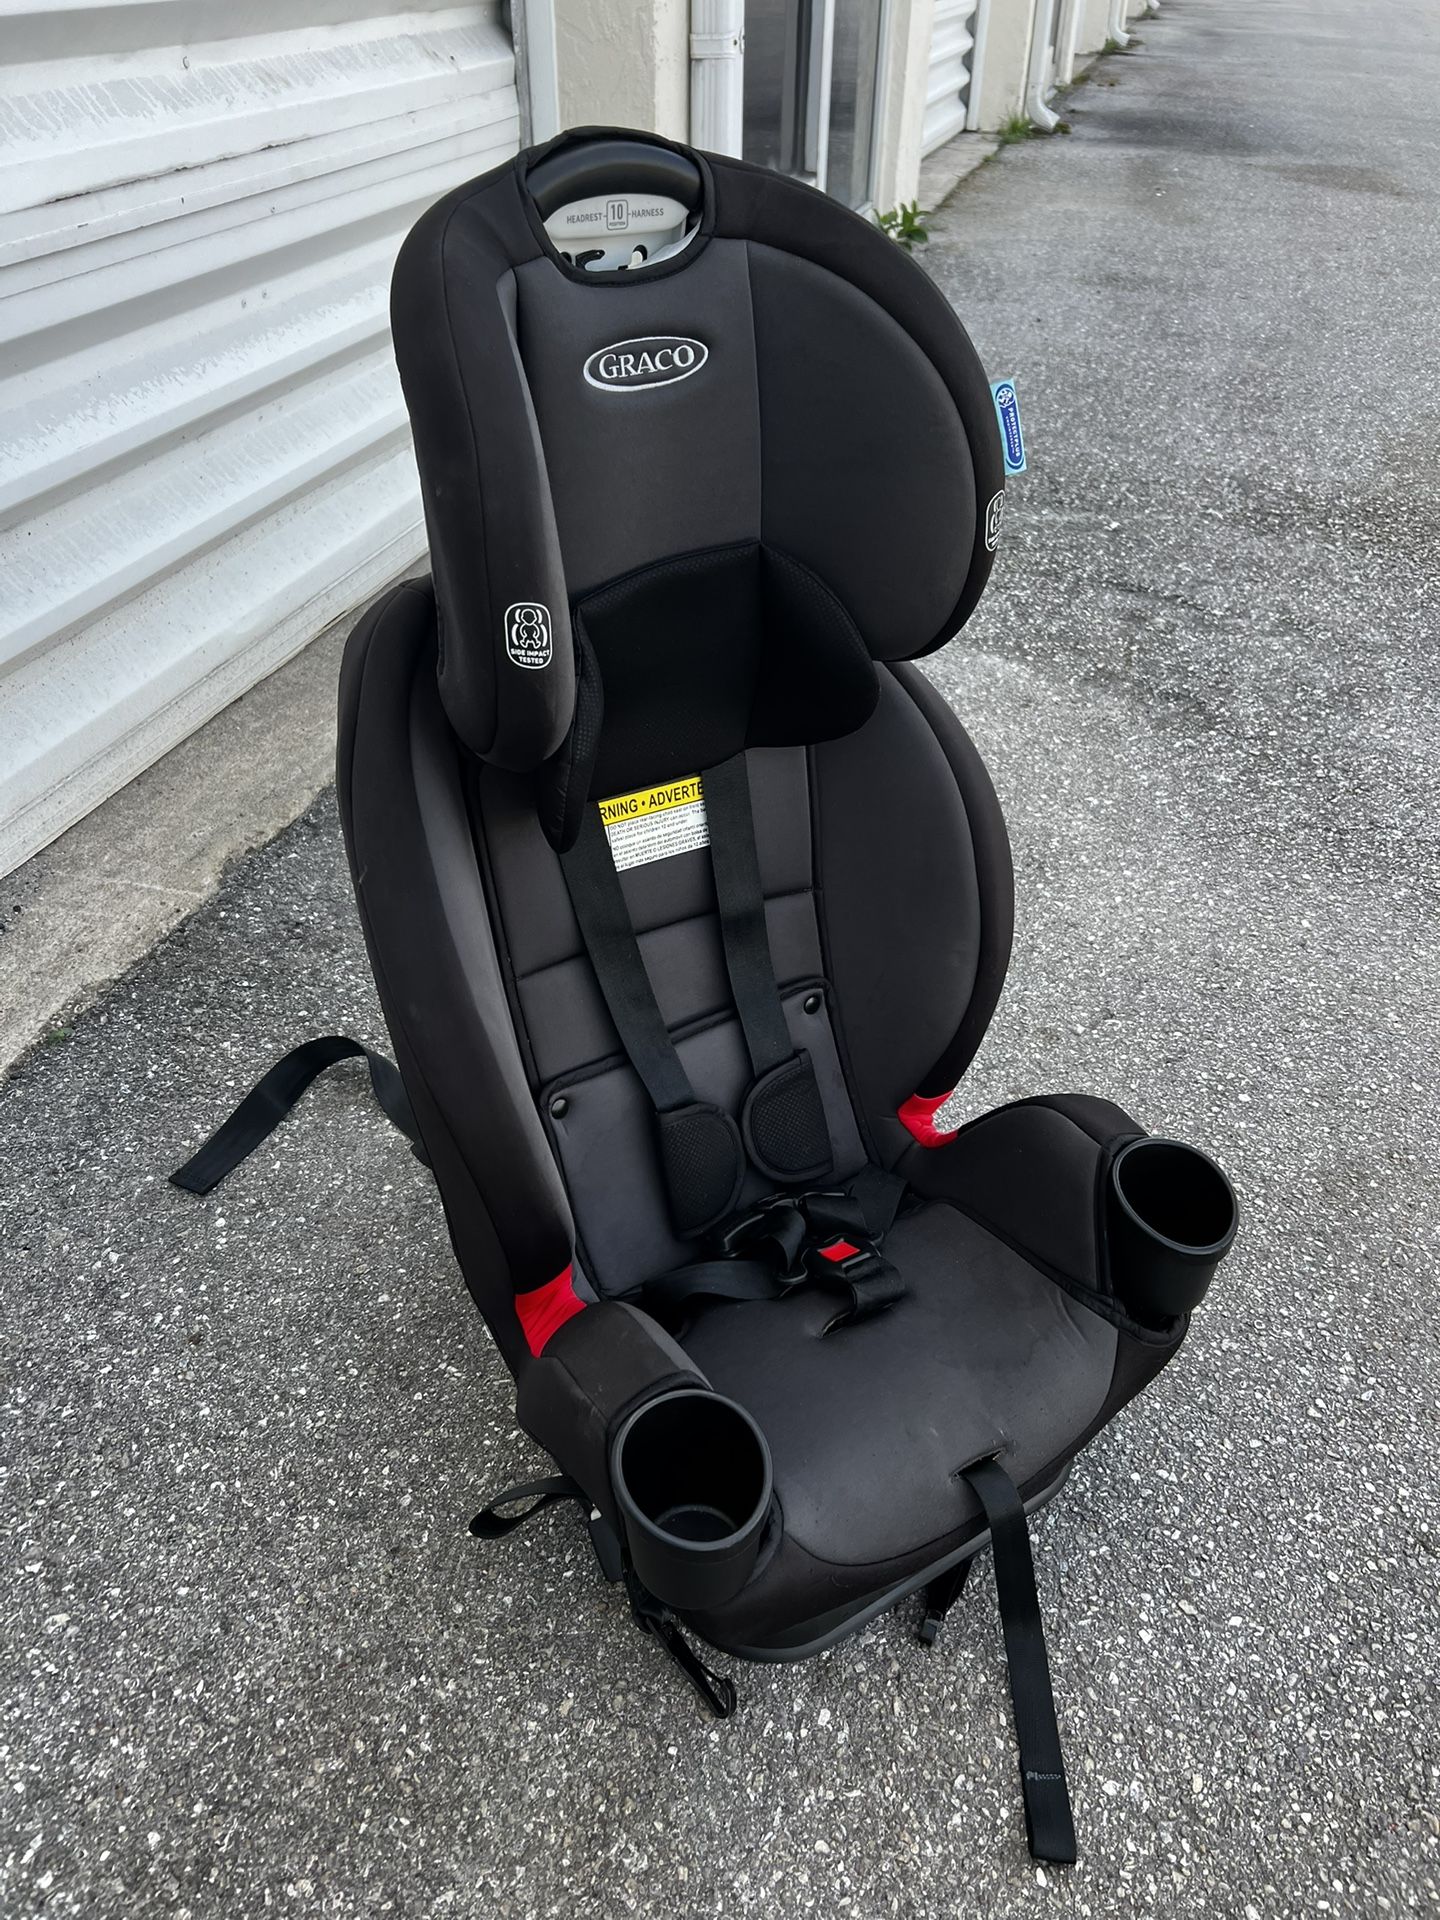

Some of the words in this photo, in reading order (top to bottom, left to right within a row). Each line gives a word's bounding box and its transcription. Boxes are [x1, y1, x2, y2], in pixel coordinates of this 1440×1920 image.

[567, 212, 603, 224] HEADREST
[610, 204, 623, 220] 10
[632, 208, 664, 218] HARNESS
[598, 344, 695, 379] GRACO
[510, 648, 526, 656] SIDE
[526, 649, 550, 657] IMPACT
[518, 656, 544, 664] TESTED
